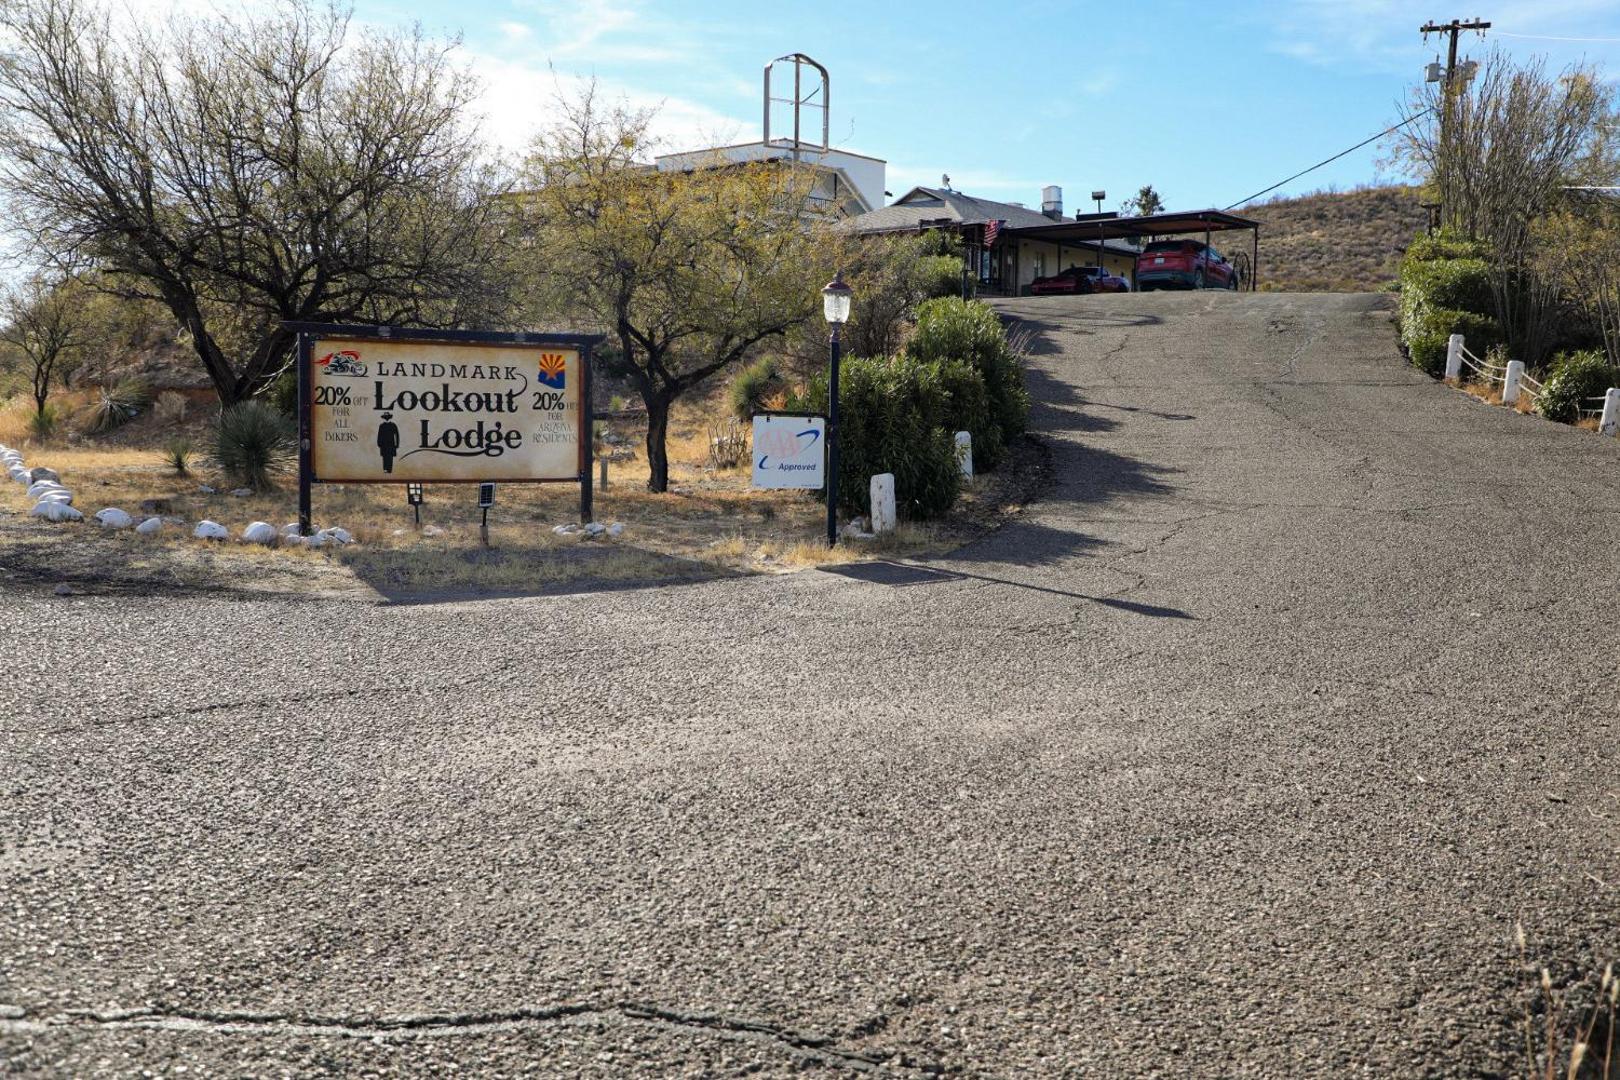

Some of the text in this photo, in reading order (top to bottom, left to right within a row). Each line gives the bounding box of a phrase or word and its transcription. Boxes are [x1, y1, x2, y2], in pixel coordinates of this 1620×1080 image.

[377, 362, 518, 380] LANDMARK
[314, 386, 351, 406] 20%
[373, 381, 519, 413] Lookout
[532, 392, 565, 410] 20%
[332, 407, 351, 417] FOR
[334, 418, 351, 429] ALL
[325, 431, 359, 441] BIKERS
[419, 420, 522, 457] Lodge
[778, 463, 816, 471] Approved
